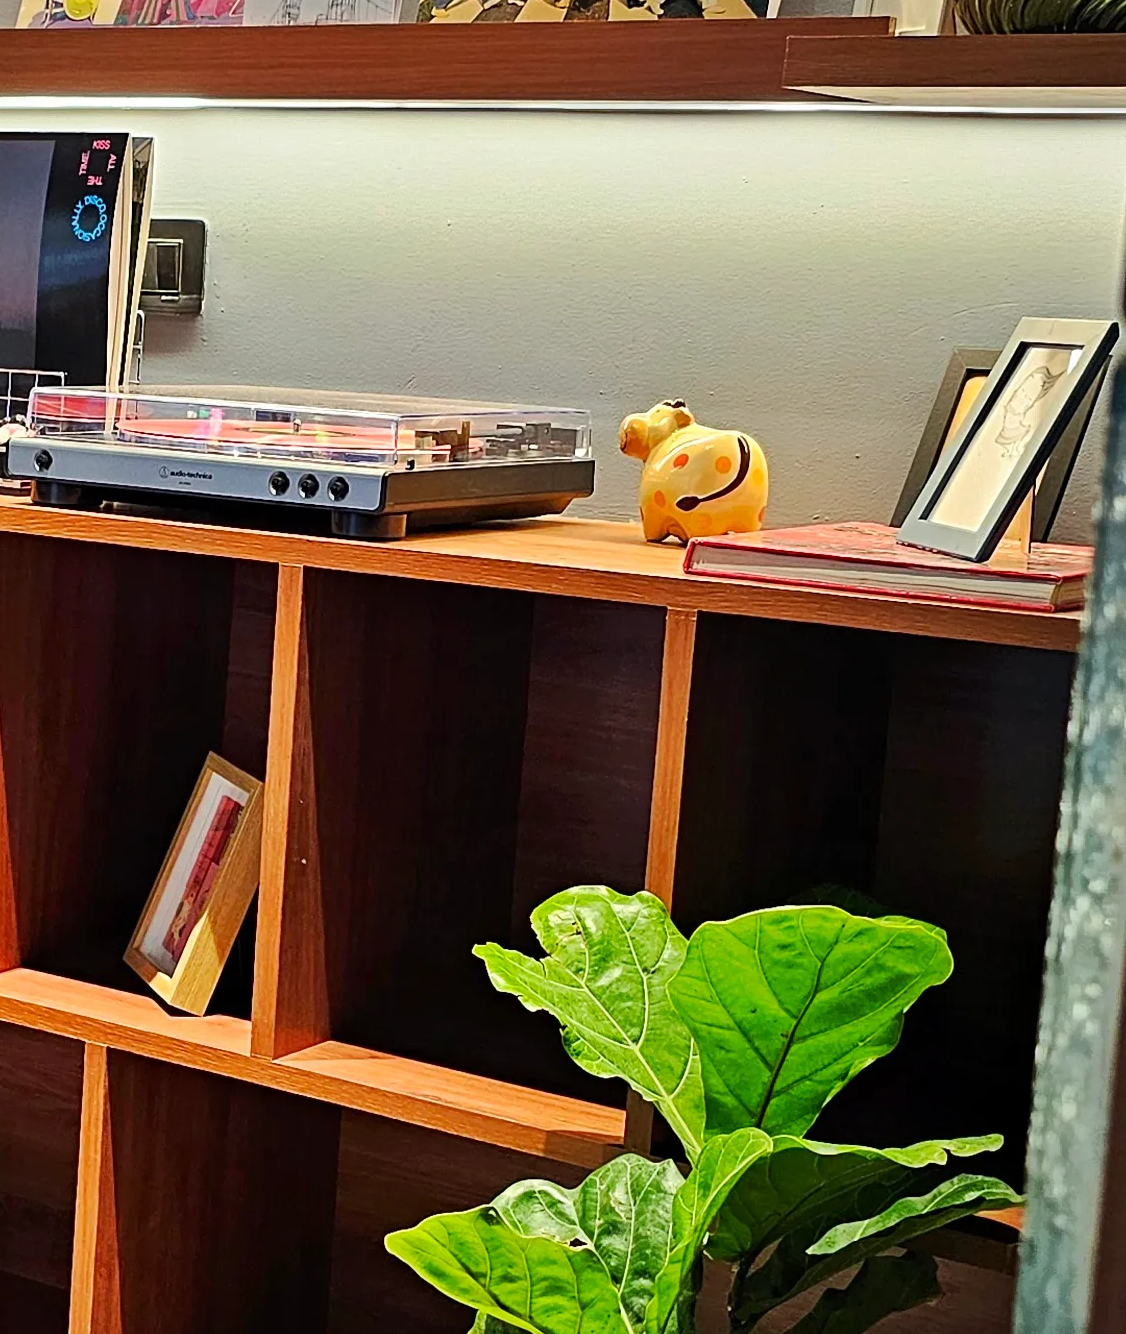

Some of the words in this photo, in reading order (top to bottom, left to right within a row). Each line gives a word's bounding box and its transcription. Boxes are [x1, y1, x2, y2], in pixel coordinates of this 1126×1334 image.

[92, 139, 111, 150] KISS
[107, 153, 117, 172] ALL
[87, 175, 103, 186] THE
